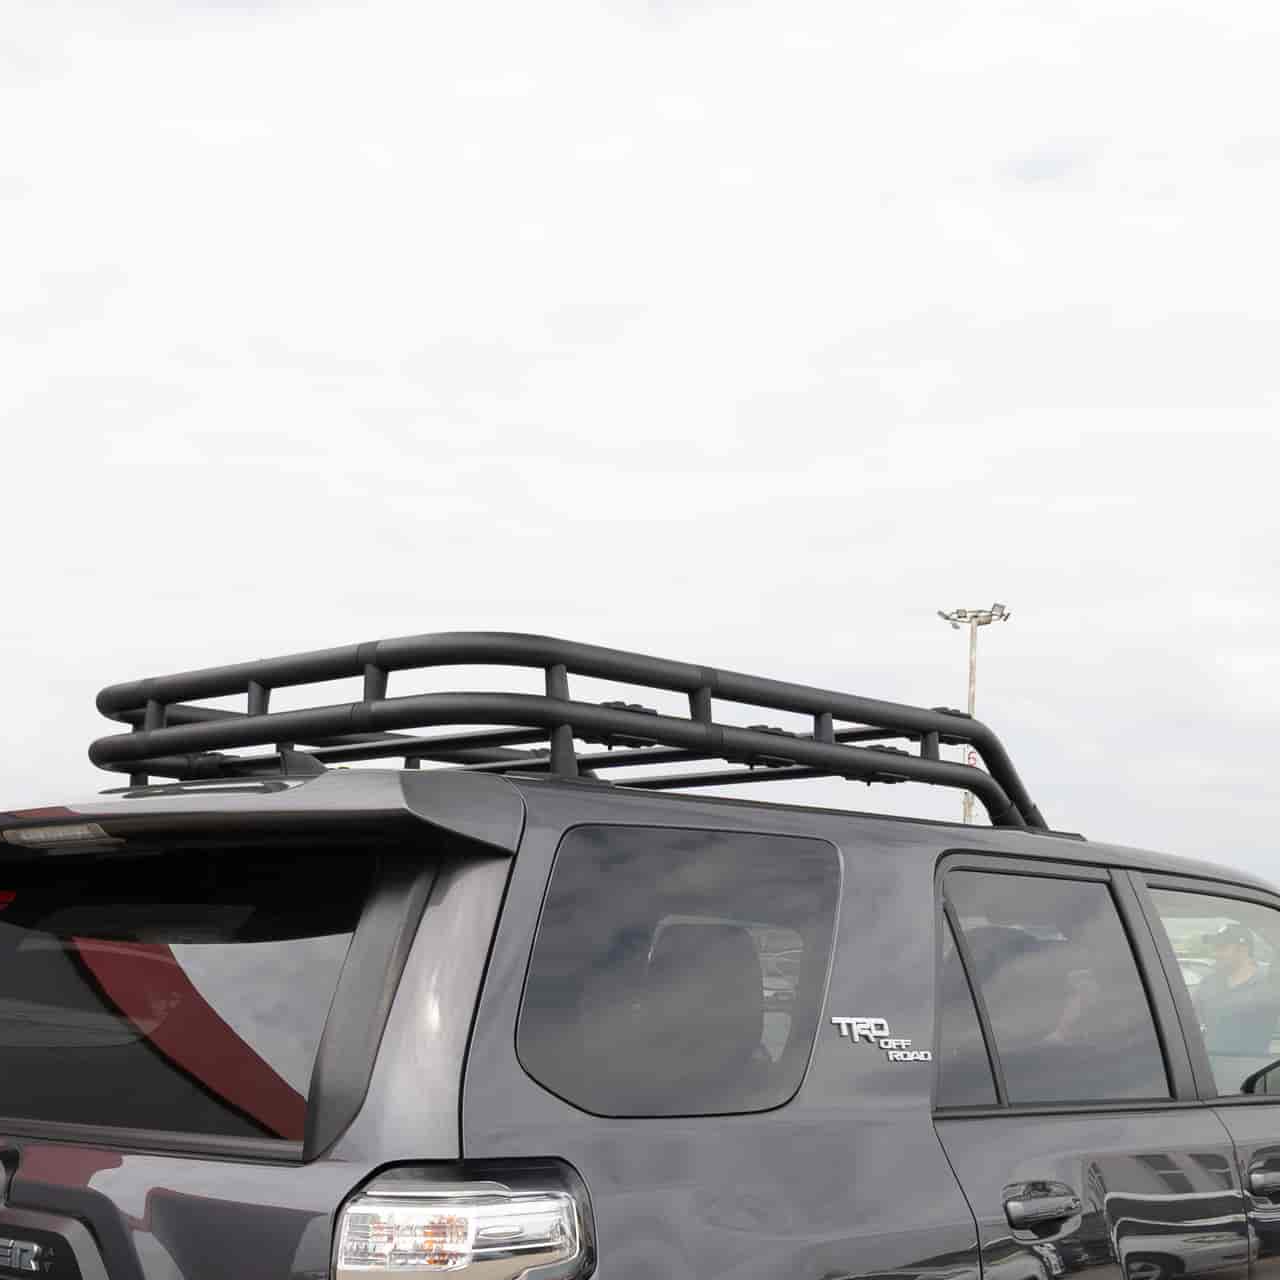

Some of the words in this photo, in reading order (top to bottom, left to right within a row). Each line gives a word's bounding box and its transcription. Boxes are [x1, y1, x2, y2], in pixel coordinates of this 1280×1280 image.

[831, 1016, 890, 1042] TRD
[879, 1039, 911, 1049] OFF
[888, 1051, 932, 1062] ROAD
